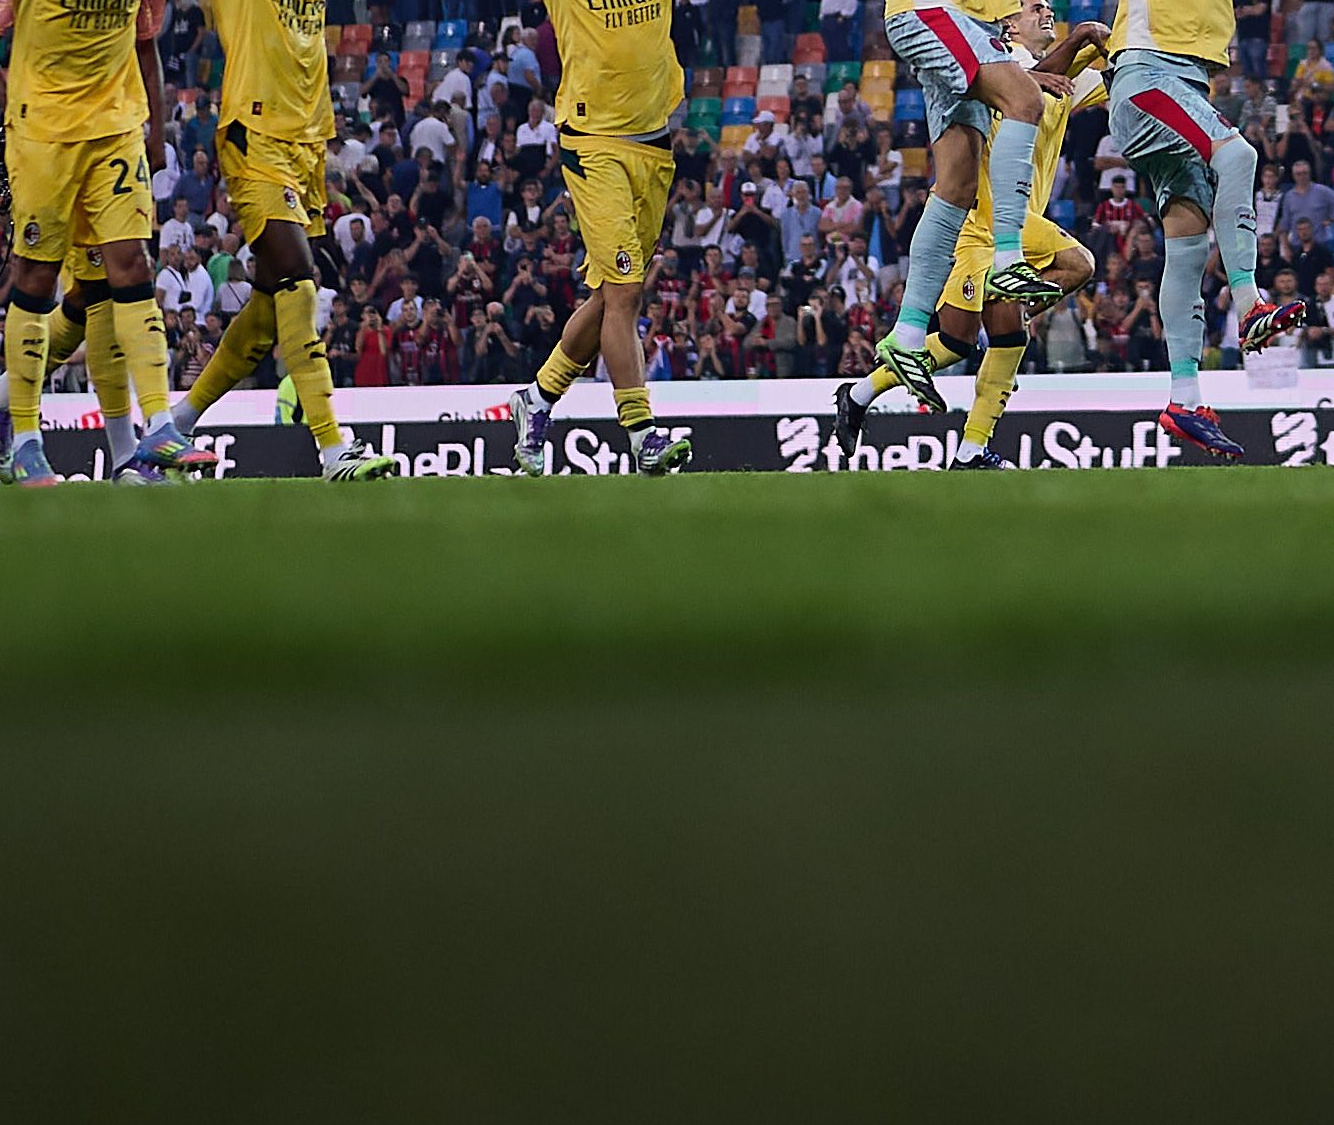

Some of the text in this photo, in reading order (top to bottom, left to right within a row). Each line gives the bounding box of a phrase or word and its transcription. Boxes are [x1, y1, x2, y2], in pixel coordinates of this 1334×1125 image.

[605, 2, 662, 28] FLY BETTER
[108, 155, 149, 195] 24
